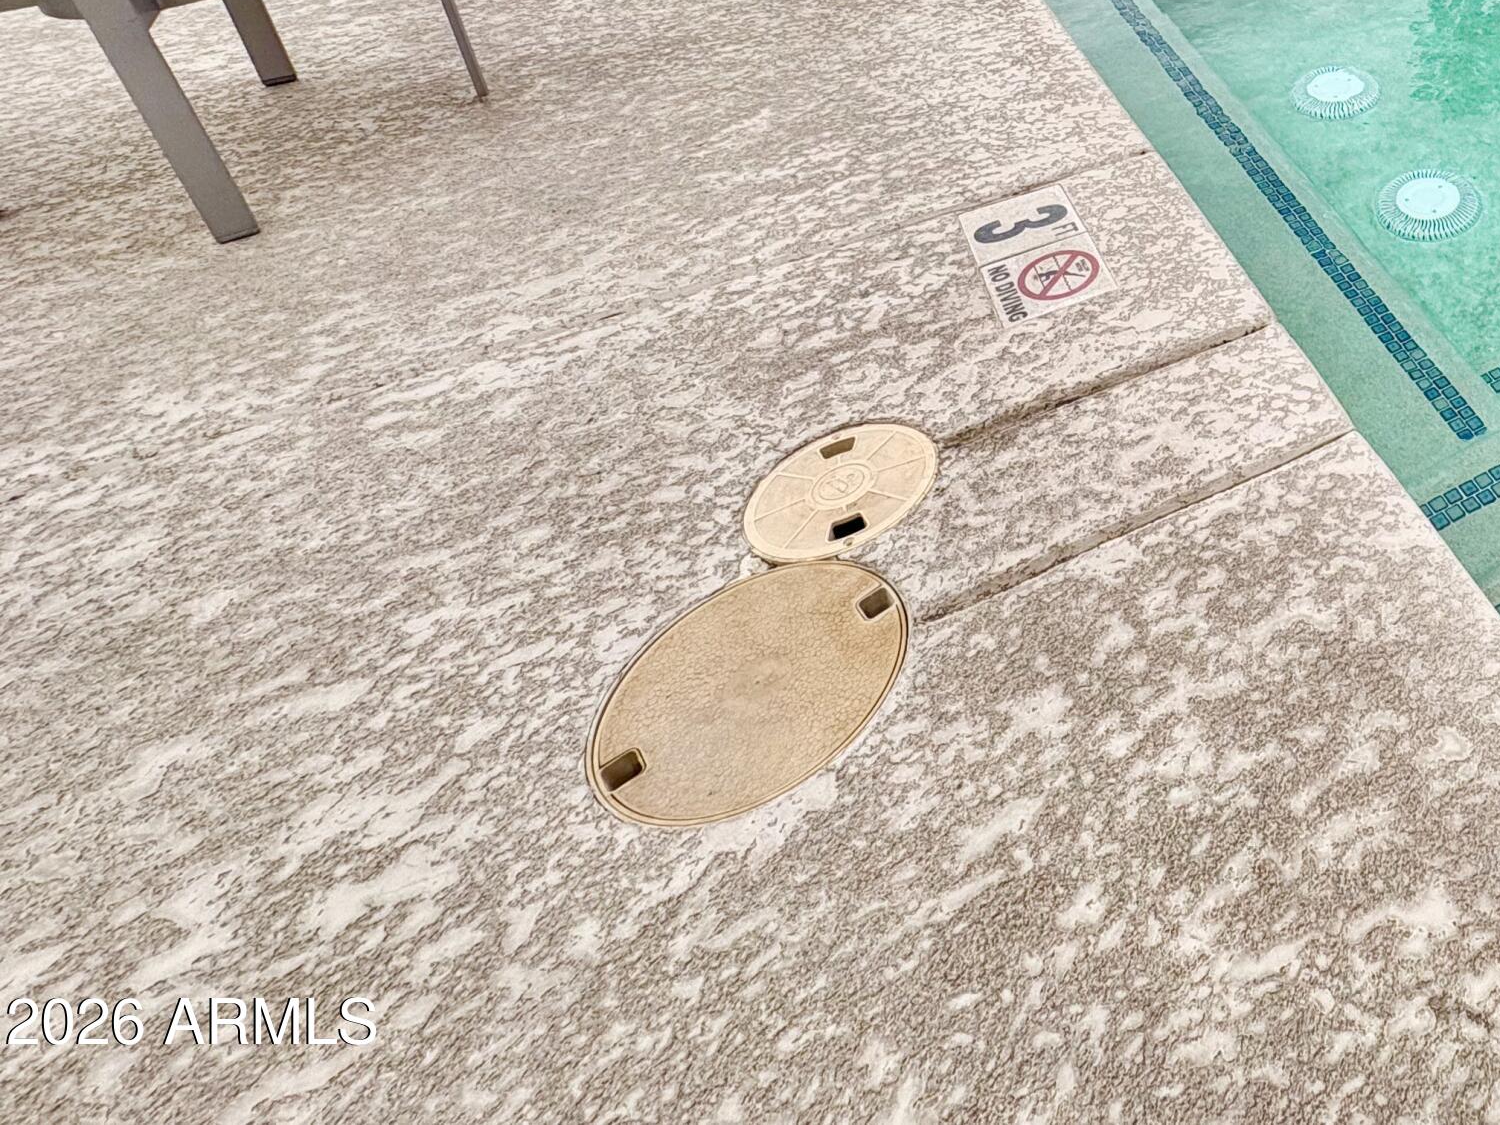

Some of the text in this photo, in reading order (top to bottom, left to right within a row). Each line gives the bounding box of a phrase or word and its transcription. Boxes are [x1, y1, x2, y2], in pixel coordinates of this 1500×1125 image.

[974, 204, 1079, 243] 3 FT
[988, 264, 1028, 322] NO DIVING
